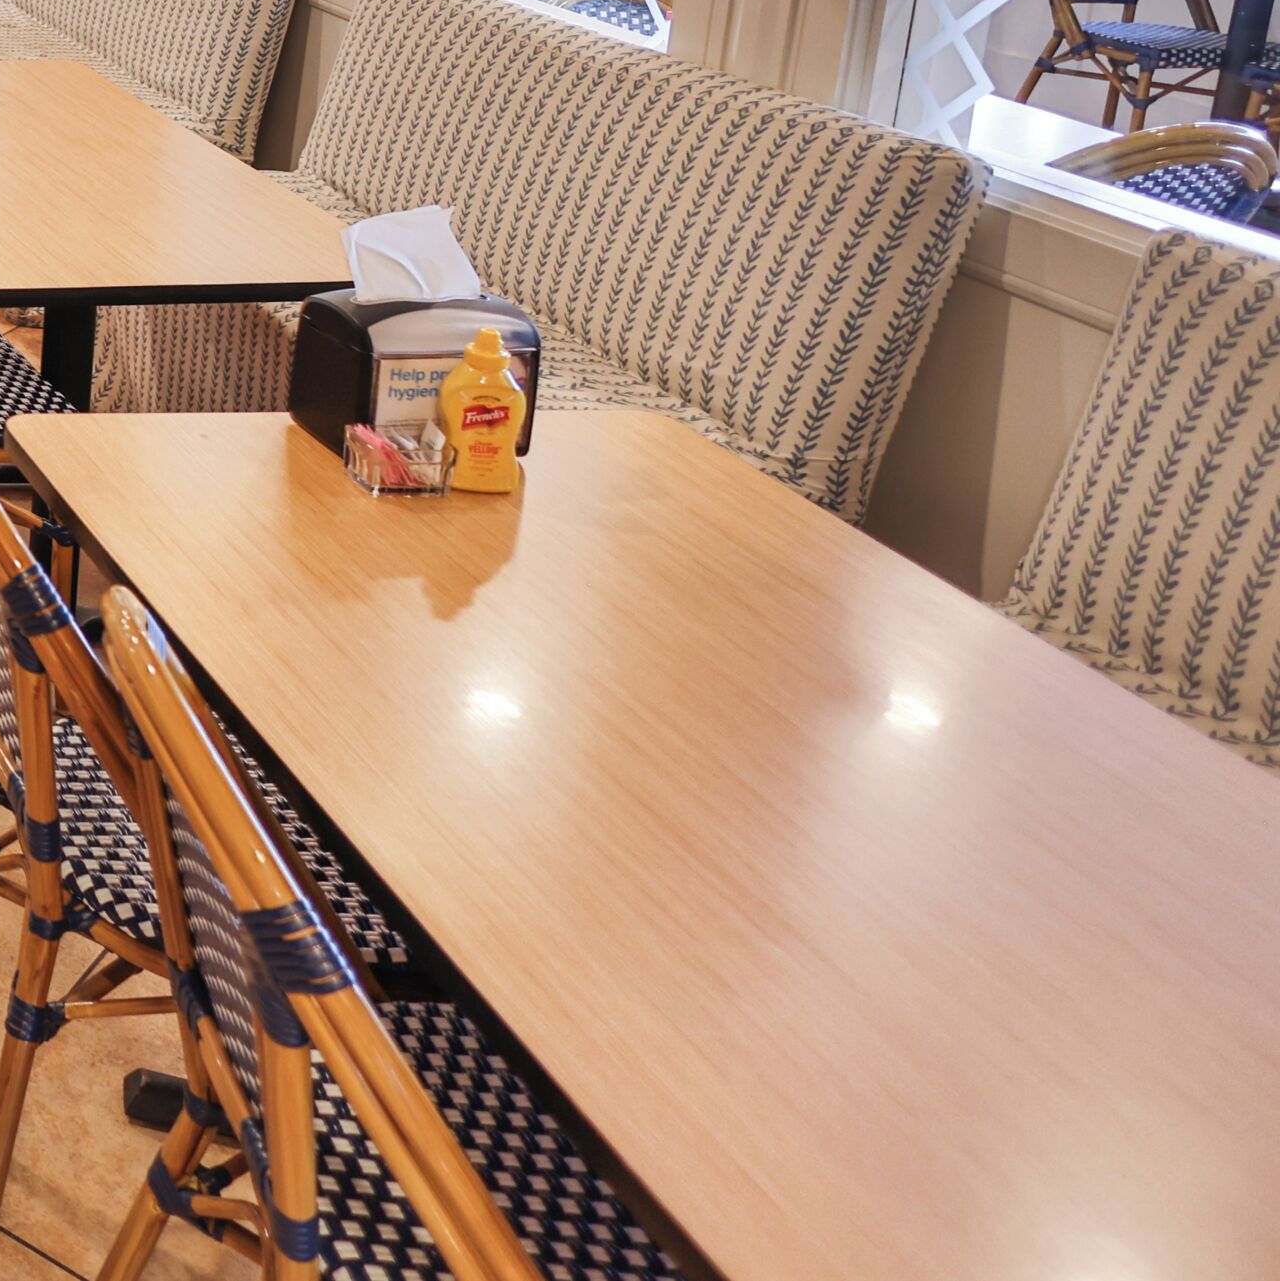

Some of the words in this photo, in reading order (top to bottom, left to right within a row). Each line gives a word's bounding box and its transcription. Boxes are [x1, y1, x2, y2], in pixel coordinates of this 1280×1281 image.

[390, 368, 426, 383] Help
[388, 384, 439, 400] hygien
[465, 410, 507, 424] French's
